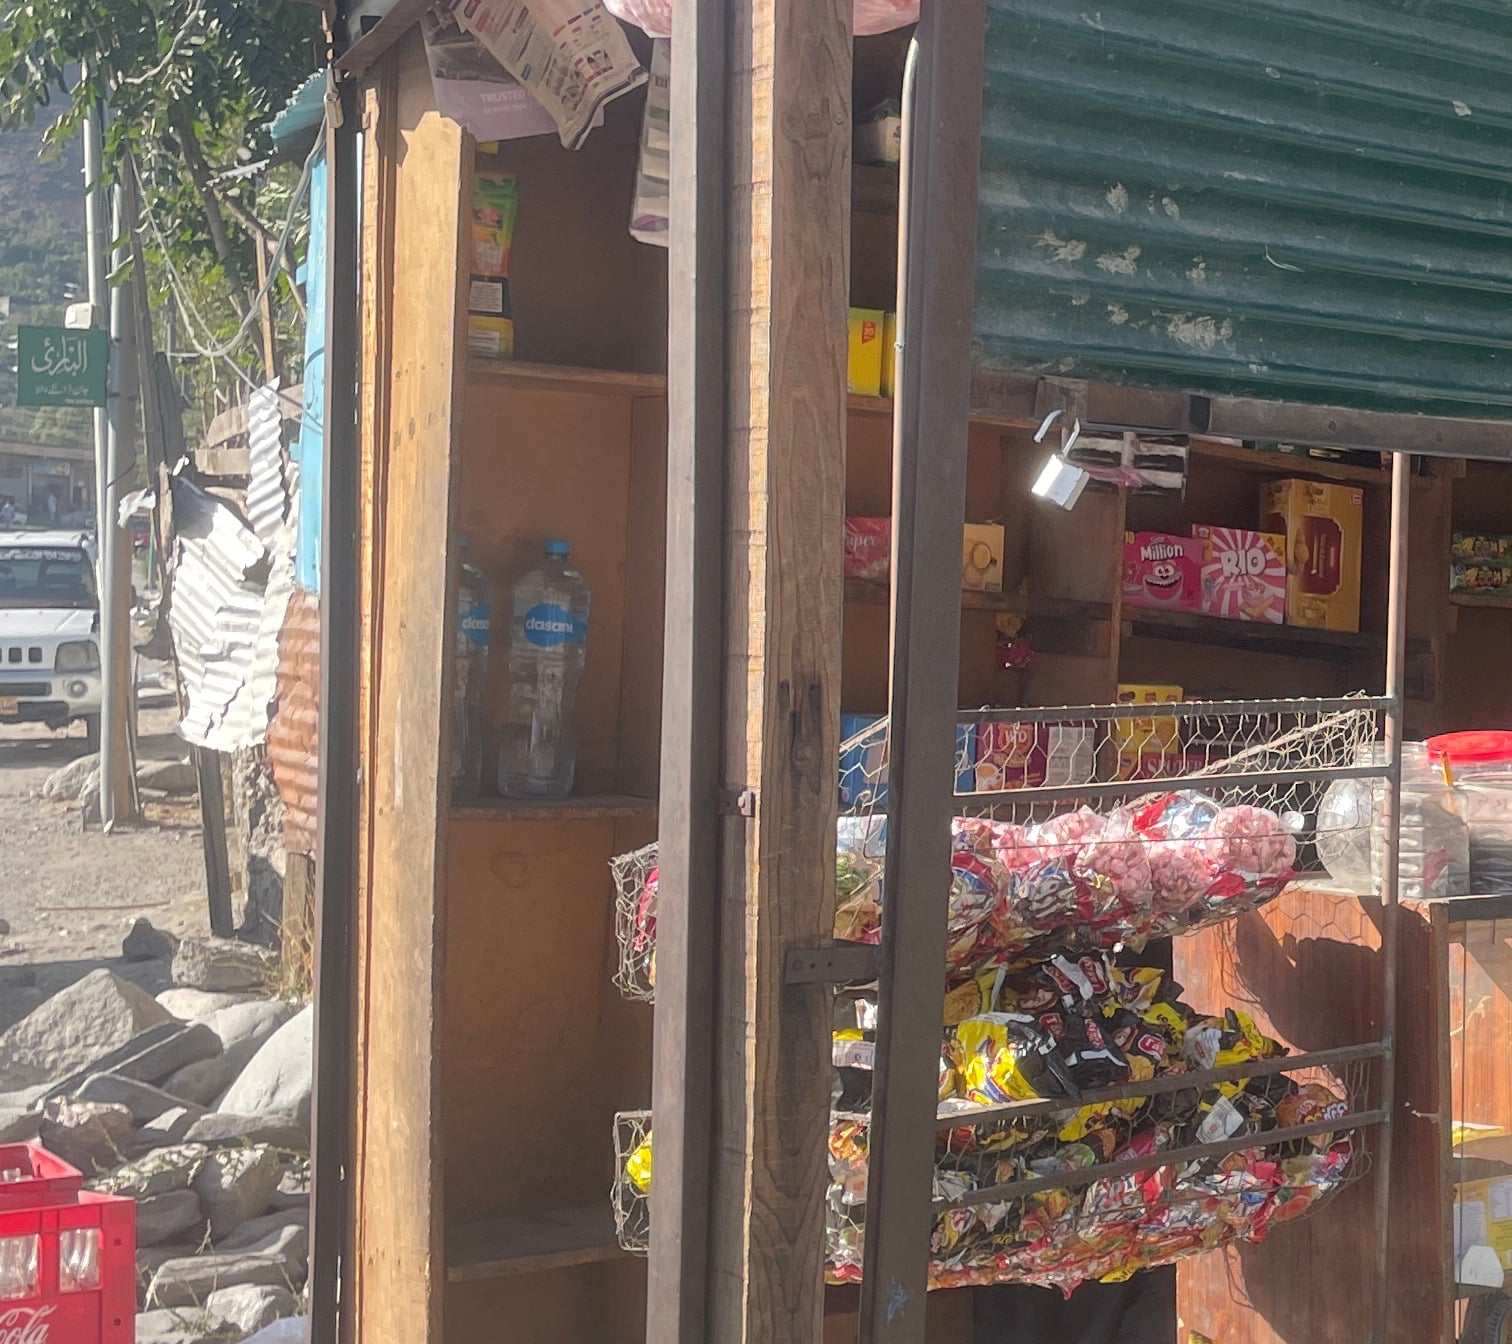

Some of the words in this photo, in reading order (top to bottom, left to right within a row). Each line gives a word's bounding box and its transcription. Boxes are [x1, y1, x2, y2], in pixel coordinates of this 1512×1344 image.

[1140, 544, 1184, 561] Million
[1220, 548, 1267, 577] RIO
[526, 617, 573, 633] dasani
